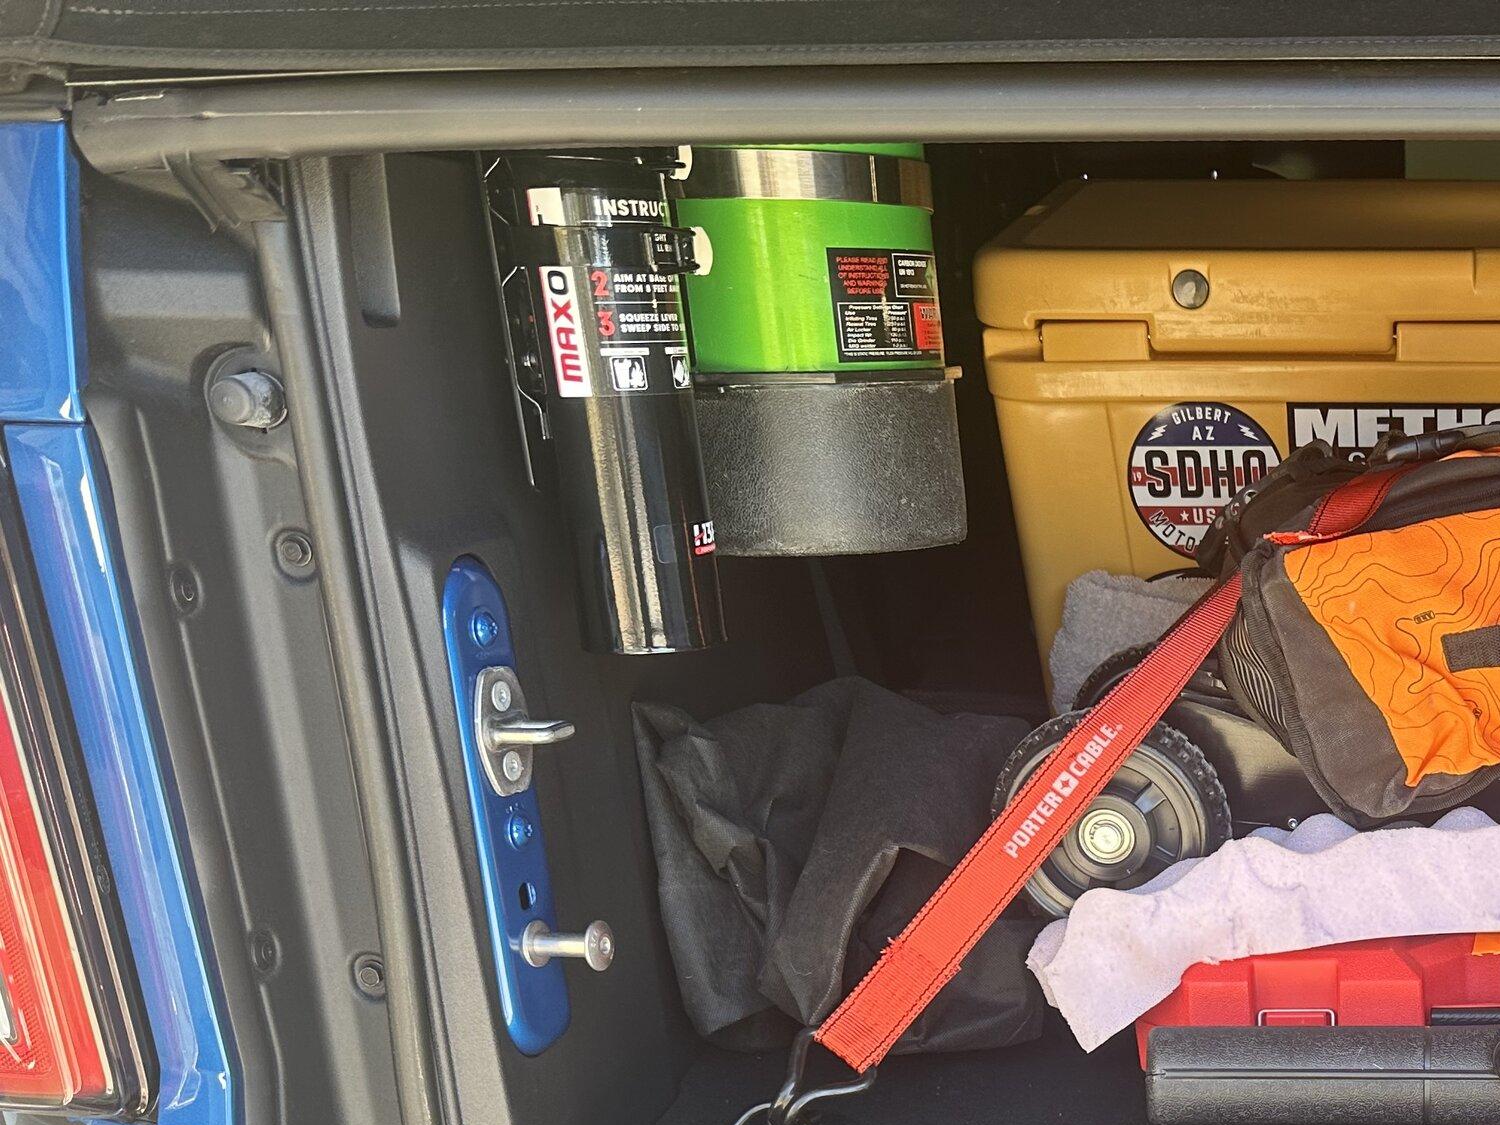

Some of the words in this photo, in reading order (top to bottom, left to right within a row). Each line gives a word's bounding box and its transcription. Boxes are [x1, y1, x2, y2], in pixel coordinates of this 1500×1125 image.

[591, 271, 609, 296] 2
[613, 274, 633, 283] AIM
[635, 274, 647, 283] AT
[614, 284, 644, 293] FROM
[653, 284, 668, 293] FEET
[597, 311, 615, 336] 3
[618, 313, 660, 323] SQUEEZE
[620, 324, 652, 333] SWEEP
[653, 324, 671, 332] SIDE
[671, 324, 679, 332] TO
[1171, 406, 1232, 426] GILBERT
[1191, 425, 1216, 441] AZ
[1131, 472, 1142, 482] 19
[1002, 791, 1064, 859] PORTER
[1068, 723, 1119, 778] CABLE
